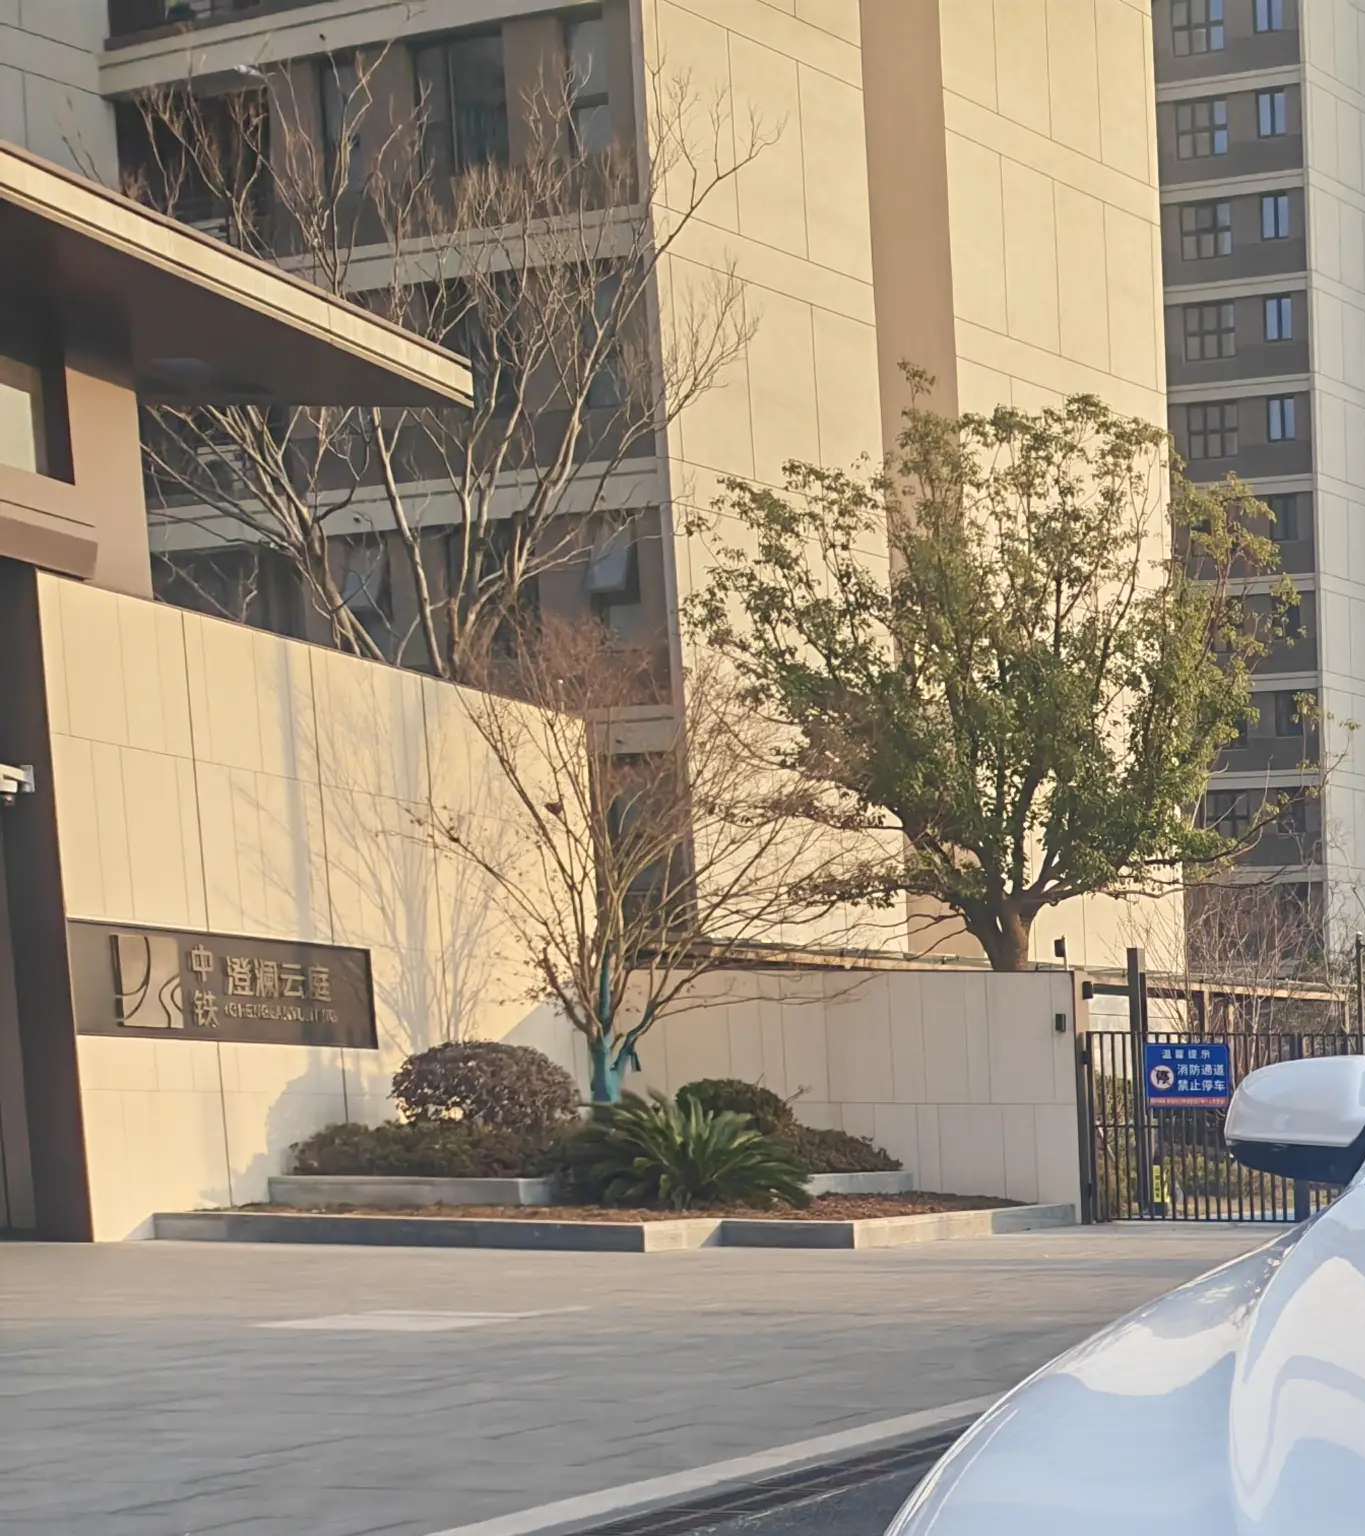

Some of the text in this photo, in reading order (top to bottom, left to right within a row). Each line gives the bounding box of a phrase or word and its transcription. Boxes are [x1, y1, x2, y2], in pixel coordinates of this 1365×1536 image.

[191, 944, 219, 1028] 中铁
[226, 956, 332, 1002] 澄澜云庭
[1177, 1064, 1225, 1076] 消防通道
[1177, 1079, 1226, 1092] 禁止停车
